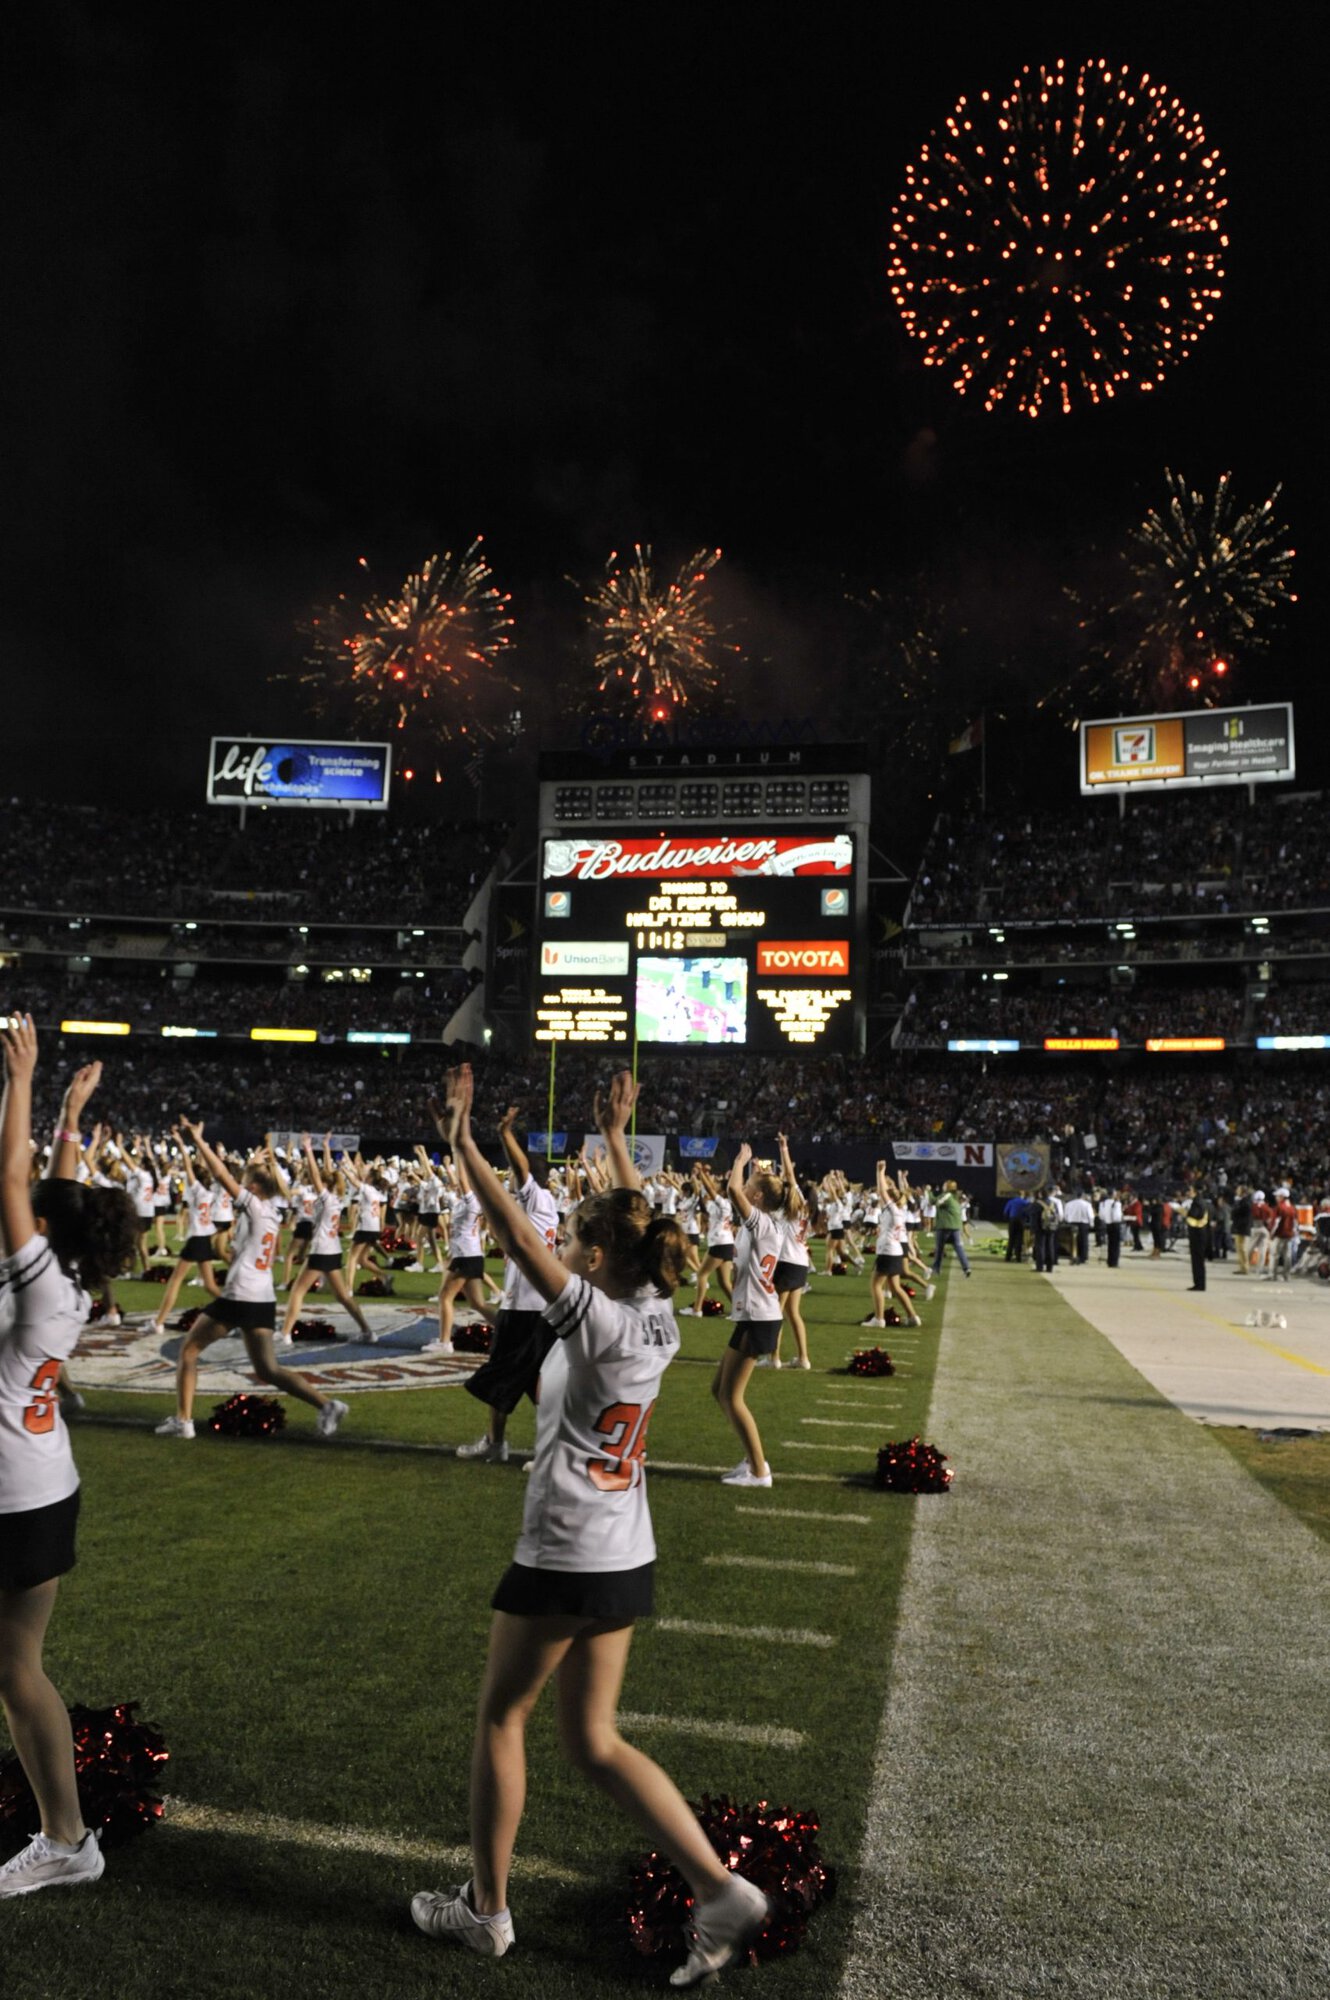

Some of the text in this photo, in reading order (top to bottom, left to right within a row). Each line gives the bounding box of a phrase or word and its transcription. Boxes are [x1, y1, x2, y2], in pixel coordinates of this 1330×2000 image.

[1188, 738, 1285, 754] Imaging Healthcare
[308, 755, 380, 770] Transforming
[628, 752, 801, 766] STADIUM
[214, 745, 273, 796] life
[323, 767, 363, 776] science
[573, 837, 777, 880] Budweiser
[710, 882, 728, 894] TO
[649, 896, 737, 911] DR PEPPER
[626, 911, 765, 927] HALFTIME SHOW
[564, 954, 625, 965] UnionBank
[762, 951, 844, 967] TOYOTA
[1046, 1038, 1118, 1049] WELLS FARGO
[964, 1145, 985, 1165] N
